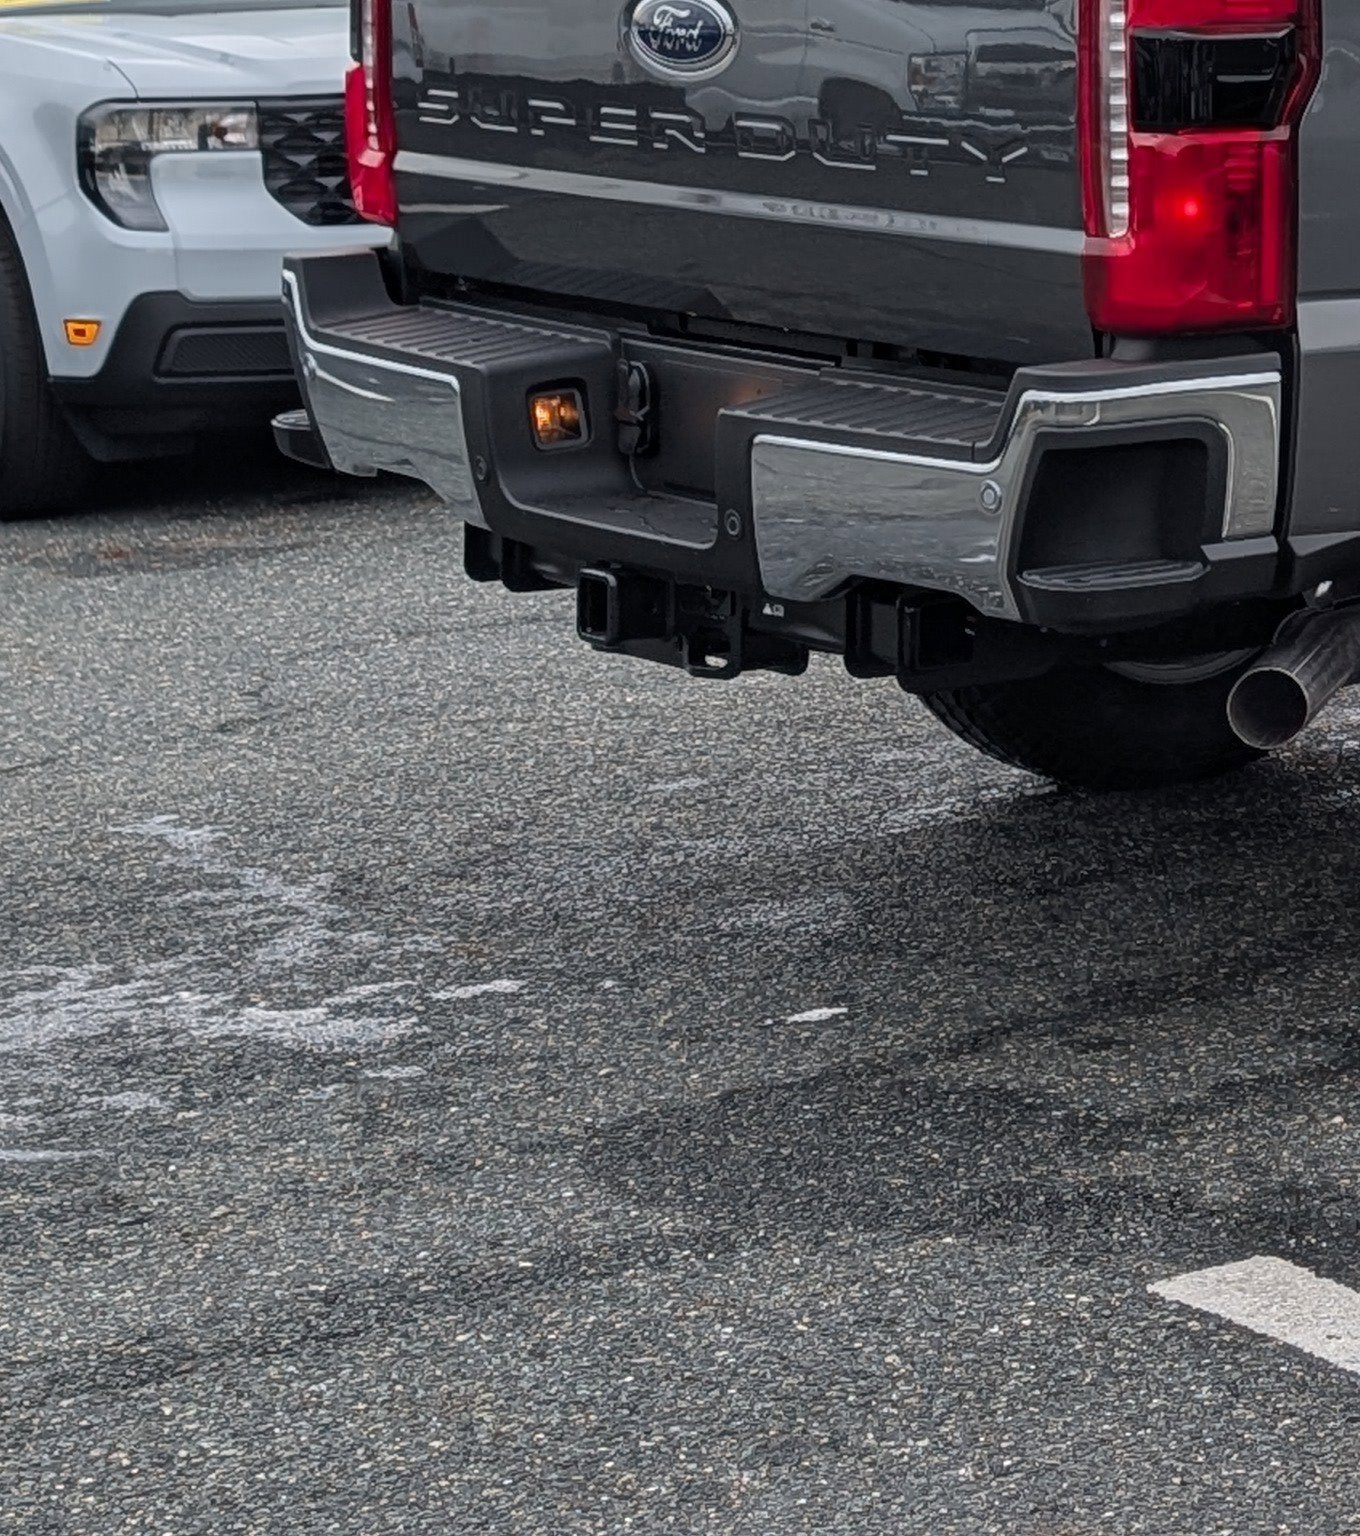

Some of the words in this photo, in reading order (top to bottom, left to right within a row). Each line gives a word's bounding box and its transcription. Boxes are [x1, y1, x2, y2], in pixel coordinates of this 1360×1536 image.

[647, 3, 706, 53] Ford
[414, 86, 708, 155] SUPER
[731, 112, 1030, 183] DUTY
